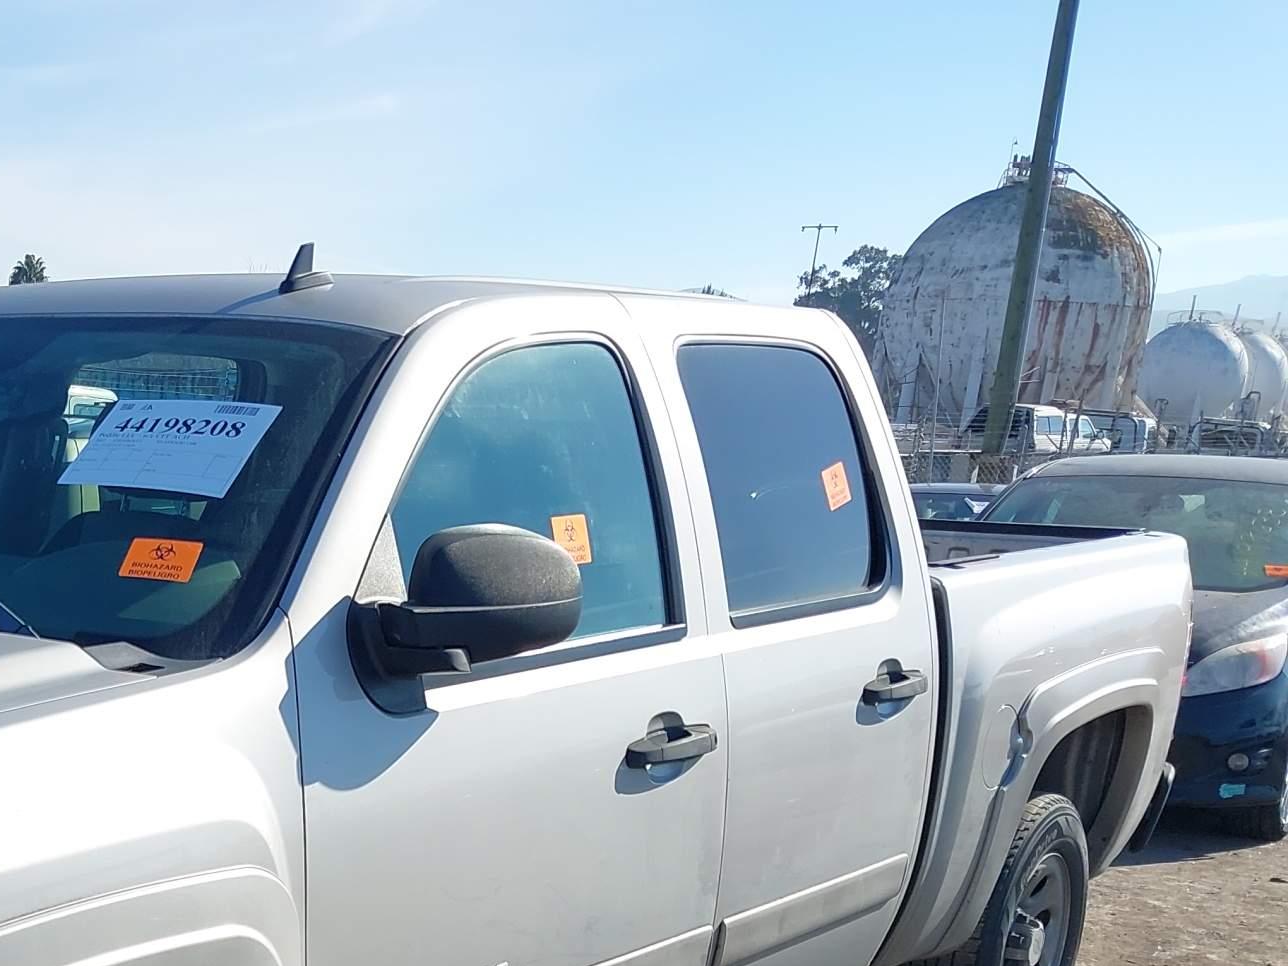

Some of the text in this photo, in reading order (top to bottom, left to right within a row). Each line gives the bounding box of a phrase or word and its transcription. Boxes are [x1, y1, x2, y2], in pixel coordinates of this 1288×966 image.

[114, 417, 246, 438] 44198208
[131, 561, 183, 572] BIOHAZARD
[128, 569, 180, 580] BIOPELIGRO
